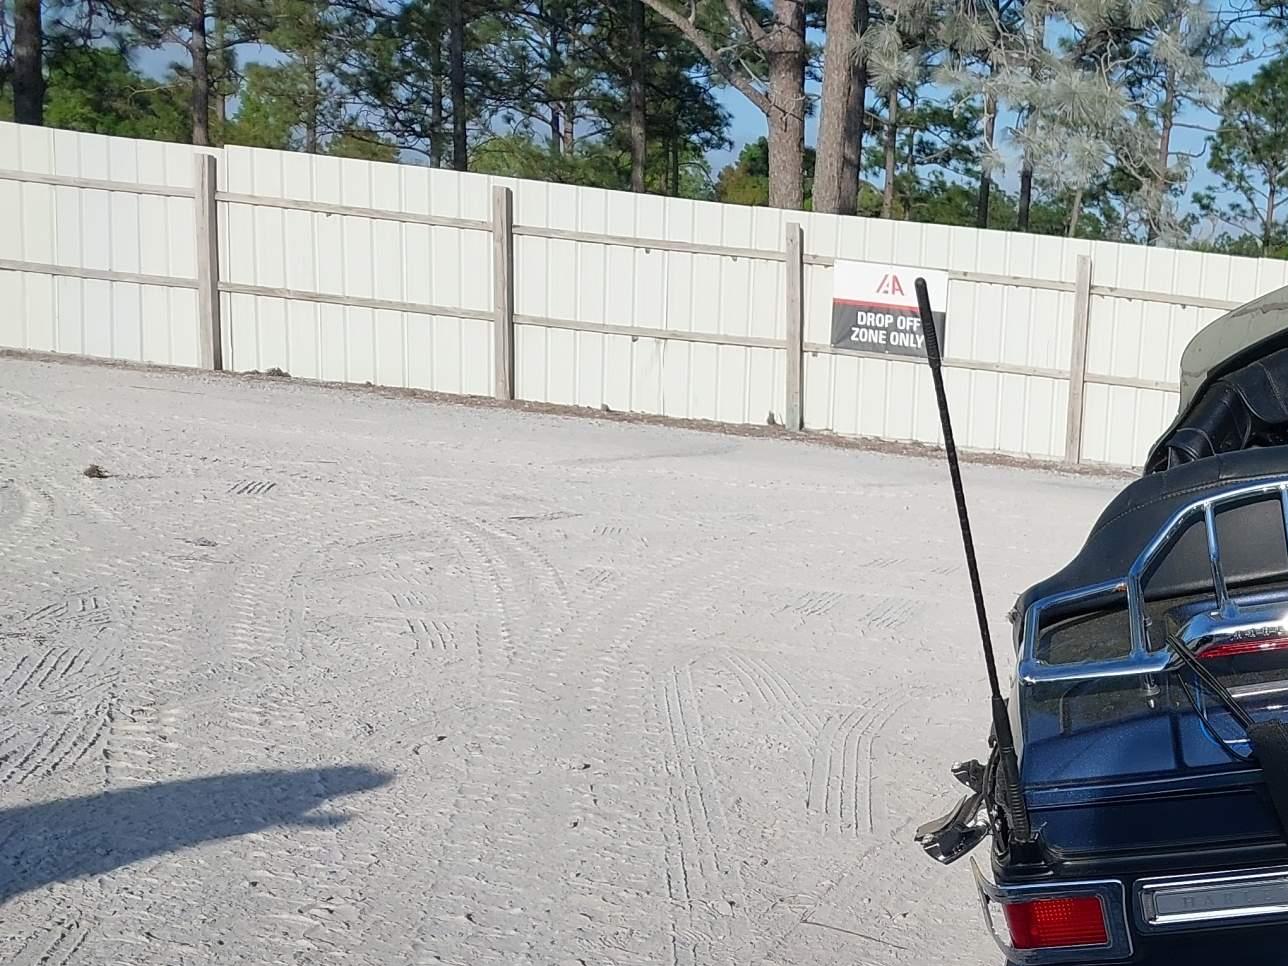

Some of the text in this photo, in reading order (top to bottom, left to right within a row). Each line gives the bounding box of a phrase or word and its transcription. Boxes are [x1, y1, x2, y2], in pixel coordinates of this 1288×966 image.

[857, 312, 921, 331] DROP OFF
[851, 328, 925, 348] ZONE ONLY
